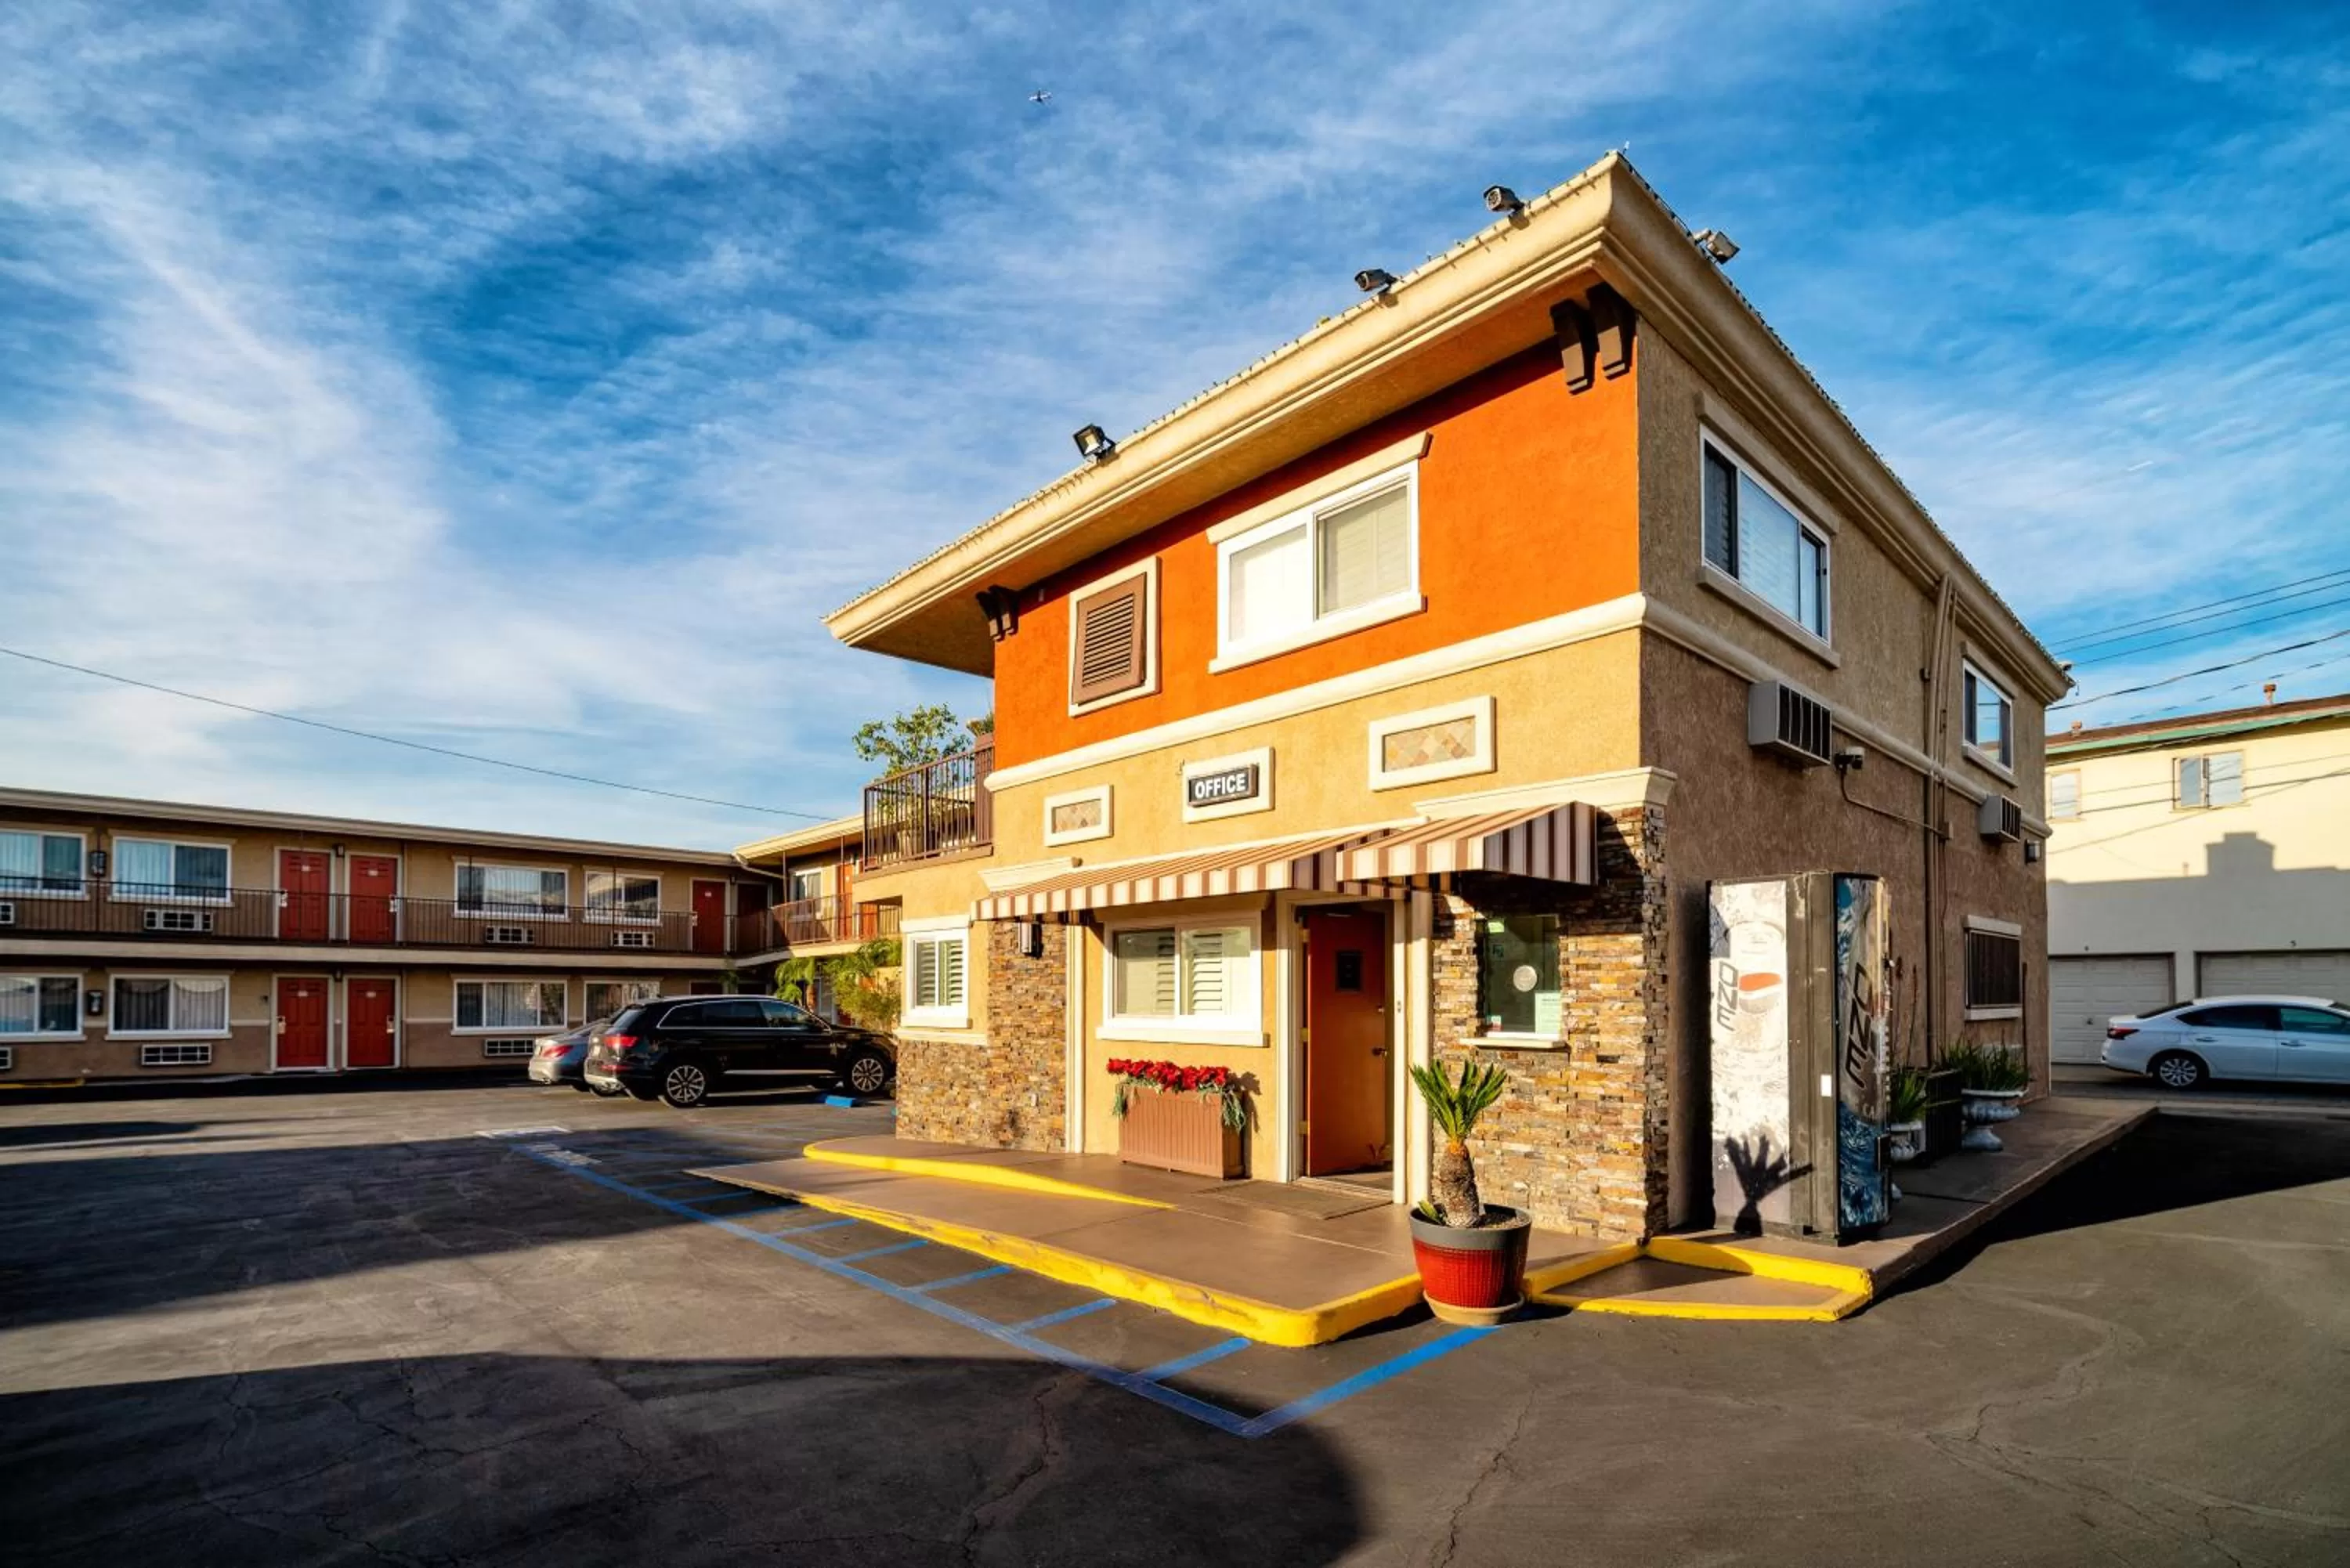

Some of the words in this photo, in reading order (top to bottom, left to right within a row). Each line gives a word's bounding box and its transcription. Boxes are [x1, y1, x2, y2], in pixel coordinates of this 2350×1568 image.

[1195, 773, 1246, 799] OFFICE
[1717, 961, 1738, 1031] ONE
[1845, 962, 1874, 1089] ONE
